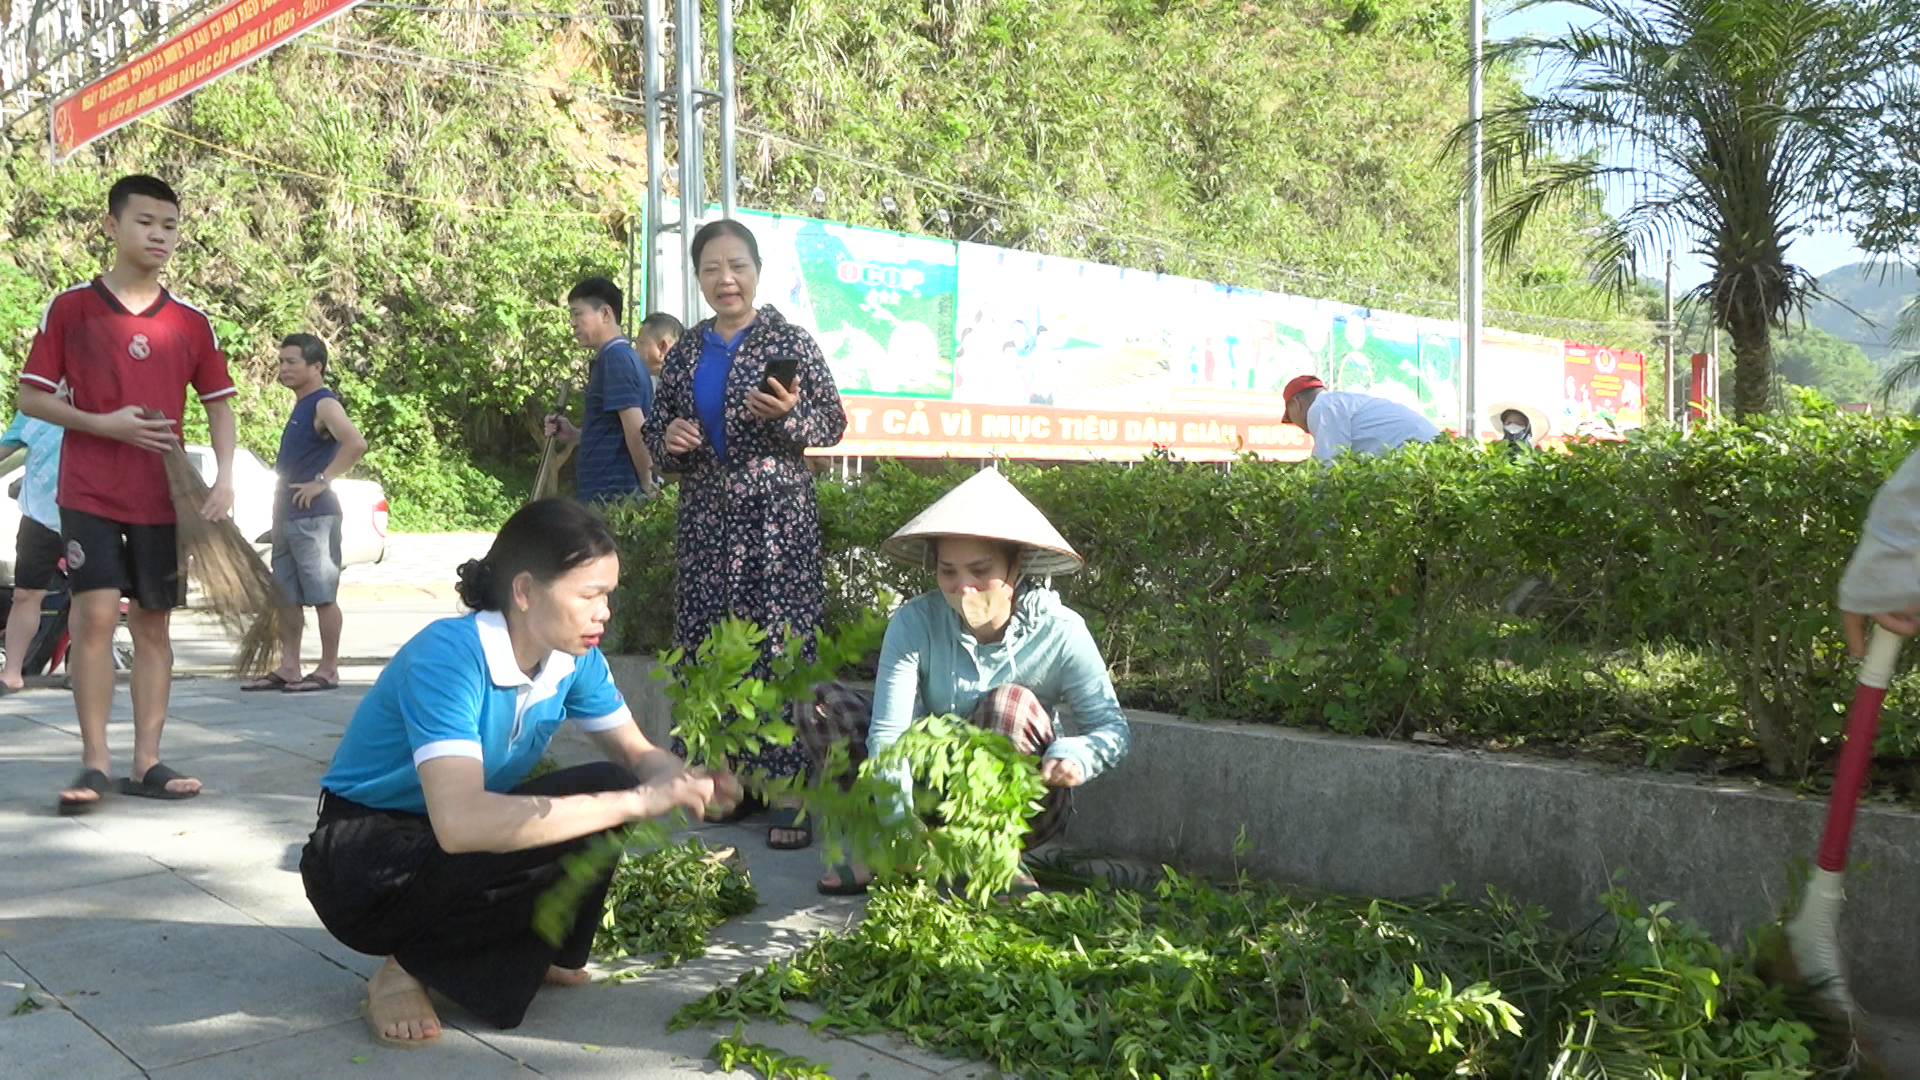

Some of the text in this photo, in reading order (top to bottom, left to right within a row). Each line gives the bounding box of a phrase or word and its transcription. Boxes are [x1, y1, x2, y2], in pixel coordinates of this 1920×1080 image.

[883, 401, 930, 435] CẢ
[941, 409, 971, 436] VÌ
[982, 414, 1050, 442] MỤC
[1058, 415, 1118, 440] TIÊU
[1125, 417, 1176, 441] DÂN
